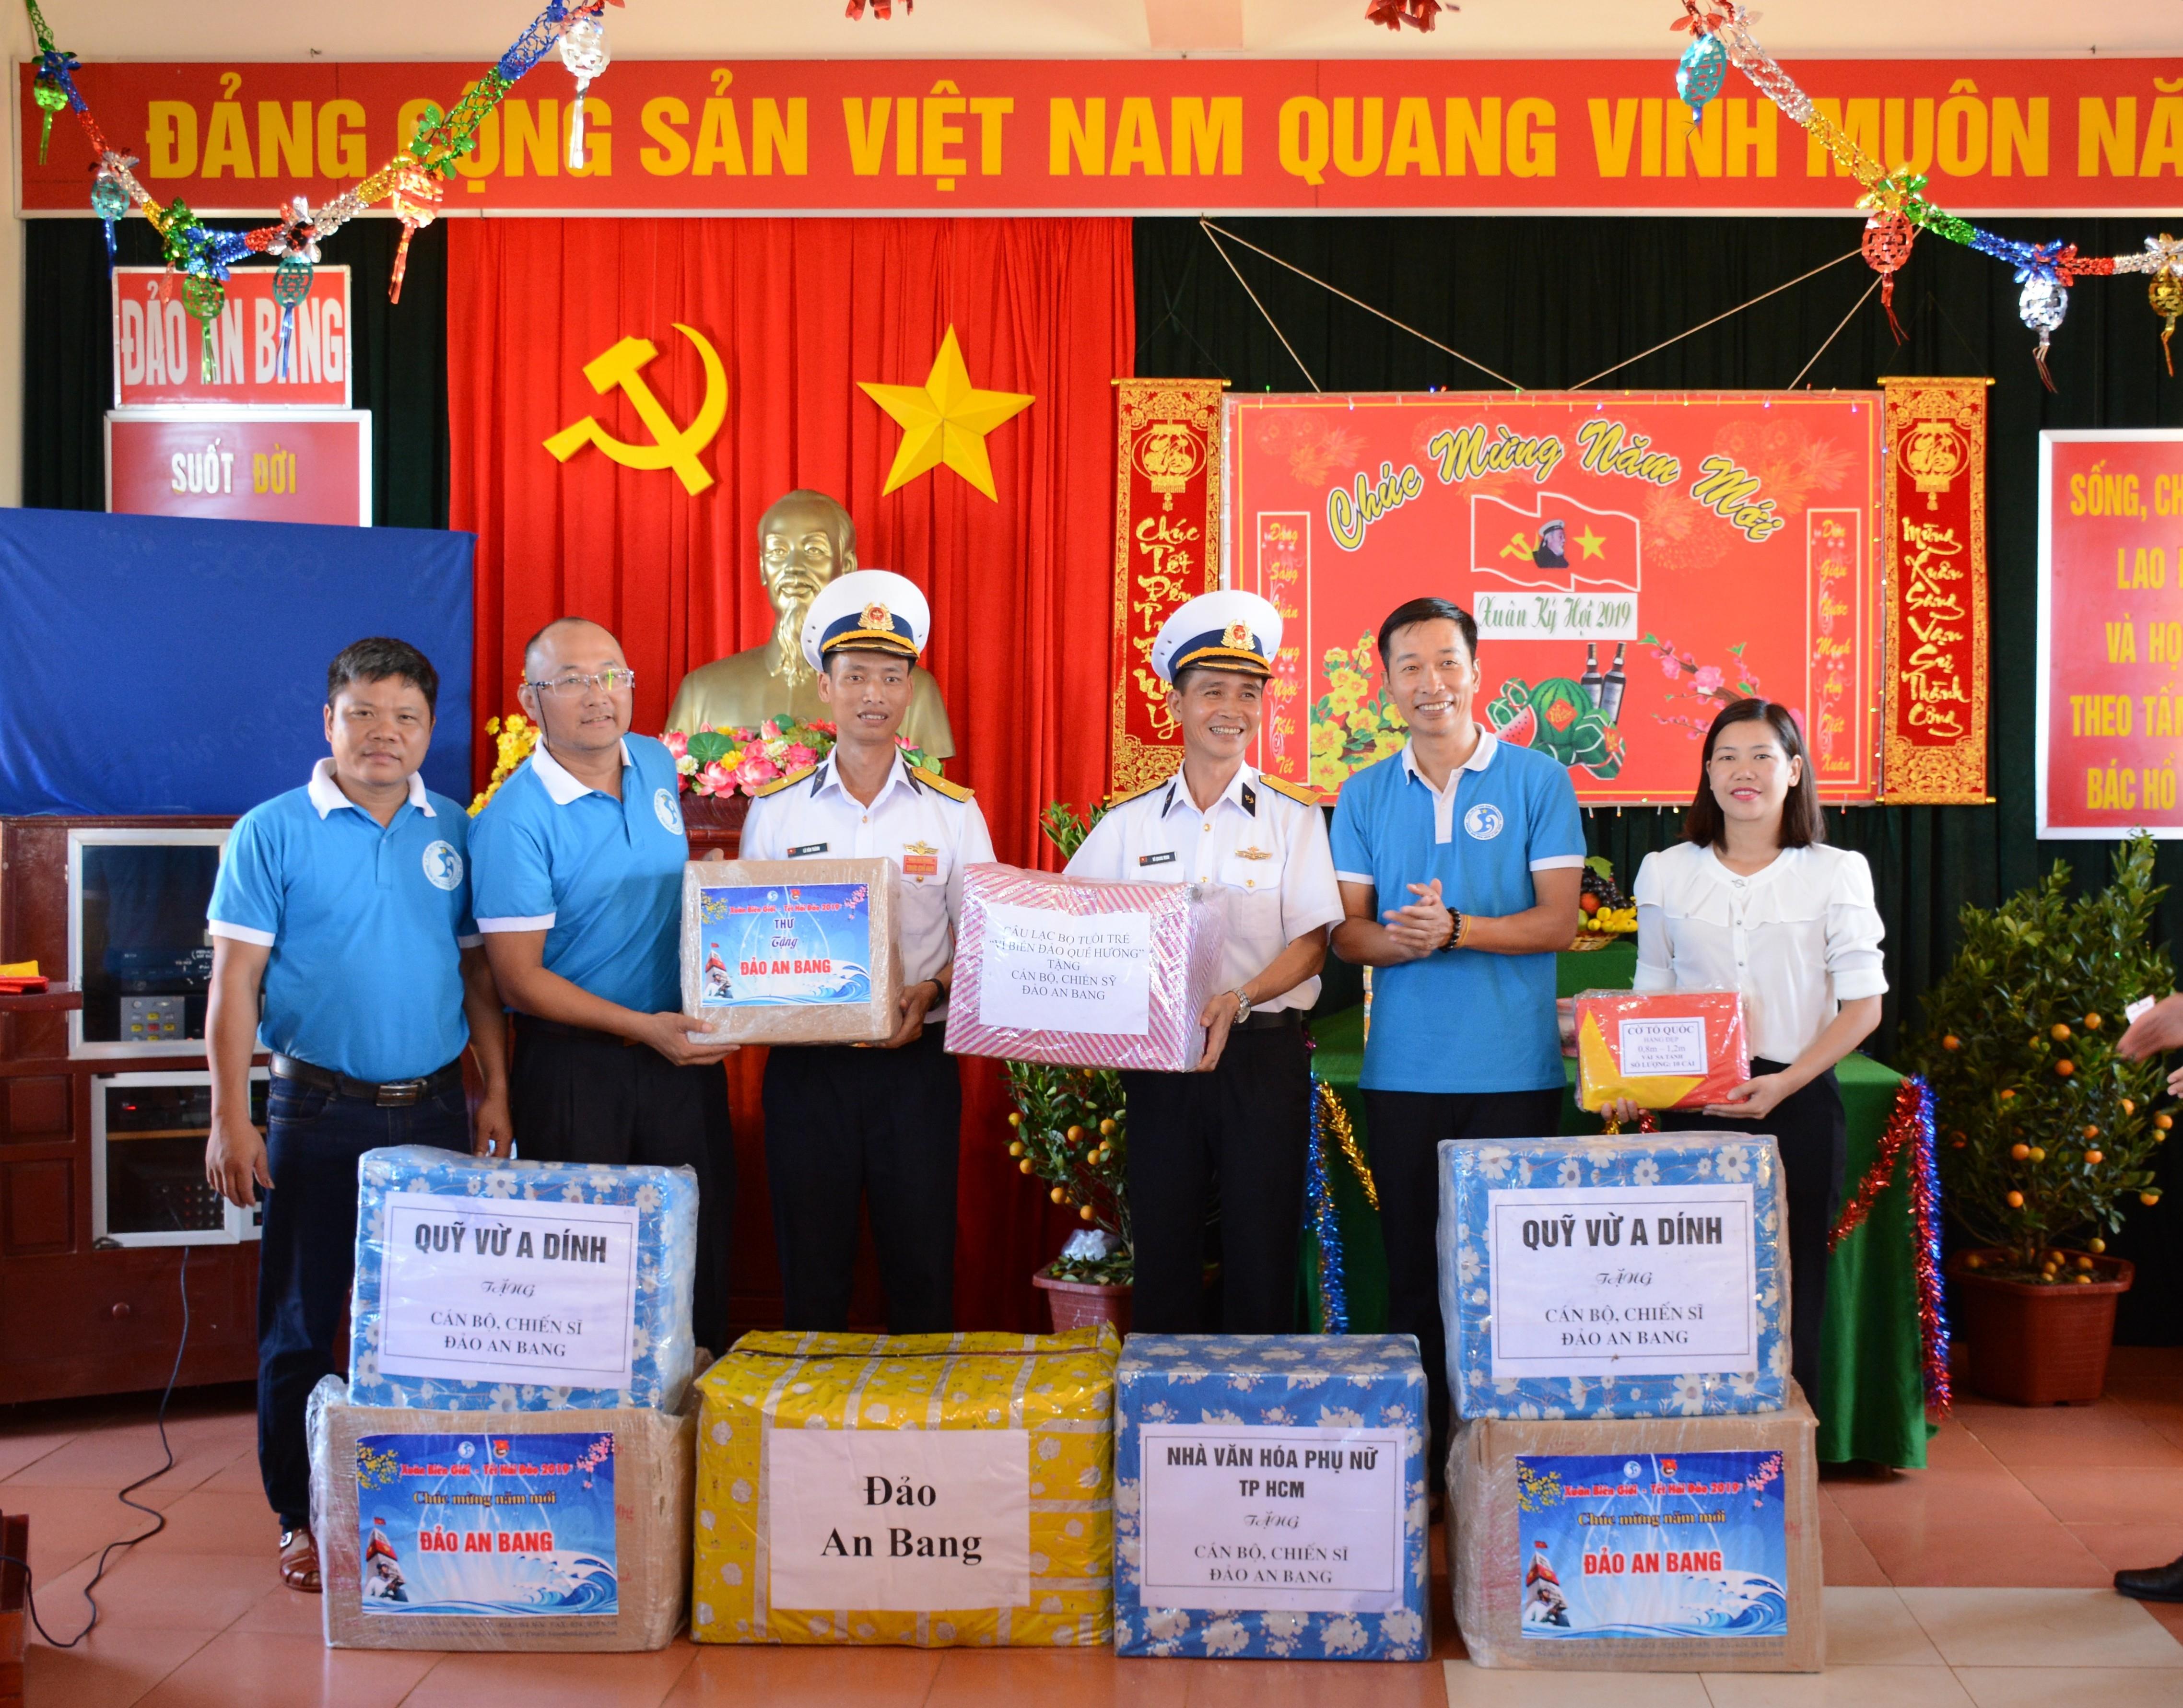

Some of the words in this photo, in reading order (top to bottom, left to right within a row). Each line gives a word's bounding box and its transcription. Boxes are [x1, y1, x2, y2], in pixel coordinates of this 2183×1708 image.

[146, 72, 366, 179] ĐẢNG
[640, 68, 808, 176] SẢN
[842, 80, 1014, 191] VIỆT
[1049, 97, 1243, 175] NAM
[1279, 96, 1556, 186] QUANG
[1587, 98, 1777, 177] VINH
[1807, 79, 2049, 178] MUÔN
[121, 281, 188, 385] ĐẢO
[255, 298, 344, 384] BANG
[171, 438, 234, 494] SUỐT
[253, 443, 296, 494] ĐỜI
[1328, 462, 1422, 551] Chúc
[1430, 425, 1563, 482] Mừng
[1578, 420, 1679, 485] Năm
[1691, 456, 1783, 540] Mới
[2070, 459, 2148, 522] SỐNG,
[1136, 515, 1200, 544] Chúc
[1140, 542, 1194, 574] Tết
[2117, 547, 2166, 590] LAO
[1596, 601, 1631, 628] 2019
[2105, 612, 2136, 664] VÀ
[2070, 694, 2133, 737] THEO
[2087, 758, 2136, 811] BÁC
[2143, 751, 2177, 811] HỒ
[1032, 930, 1055, 941] LẠC
[740, 956, 767, 976] ĐẢO
[771, 960, 790, 975] AN
[794, 959, 831, 974] BANG
[1011, 968, 1036, 981] CÁN
[1047, 959, 1080, 971] TẶNG
[1022, 983, 1048, 996] ĐẢO
[1051, 988, 1068, 997] AN
[1071, 989, 1105, 1000] BANG
[415, 1221, 466, 1254] QUỸ
[475, 1222, 513, 1256] VỪ
[516, 1231, 534, 1259] A
[543, 1228, 607, 1263] DÍNH
[1522, 1214, 1576, 1251] QUỸ
[1585, 1212, 1624, 1247] VỪ
[1630, 1218, 1649, 1246] A
[1658, 1211, 1723, 1245] DÍNH
[431, 1309, 468, 1327] CÁN
[472, 1312, 501, 1333] BỘ,
[506, 1313, 562, 1334] CHIẾN
[1545, 1305, 1584, 1322] CÁN
[1590, 1305, 1620, 1326] BỘ,
[1624, 1302, 1683, 1322] CHIẾN
[444, 1332, 482, 1352] ĐẢO
[487, 1339, 512, 1353] AN
[516, 1341, 566, 1357] BANG
[1561, 1327, 1601, 1346] ĐẢO
[1607, 1332, 1631, 1345] AN
[1638, 1331, 1689, 1345] BANG
[1167, 1443, 1208, 1466] NHÀ
[1214, 1444, 1253, 1468] VĂN
[1260, 1445, 1299, 1469] HÓA
[1305, 1450, 1343, 1474] PHỤ
[1350, 1446, 1379, 1471] NỮ
[413, 1491, 449, 1505] Chúc
[863, 1475, 937, 1507] Đảo
[1239, 1479, 1260, 1497] TP
[1266, 1481, 1305, 1498] HCM
[1578, 1510, 1615, 1526] Chúc
[420, 1526, 459, 1552] ĐẢO
[464, 1533, 492, 1553] AN
[498, 1532, 553, 1553] BANG
[820, 1527, 873, 1556] An
[887, 1527, 982, 1566] Bang
[1195, 1543, 1231, 1559] CÁN
[1271, 1543, 1327, 1561] CHIẾN
[1209, 1565, 1248, 1581] ĐẢO
[1254, 1569, 1277, 1582] AN
[1283, 1569, 1332, 1584] BANG
[1584, 1547, 1625, 1575] ĐẢO
[1631, 1553, 1659, 1573] AN
[1666, 1551, 1722, 1573] BANG
